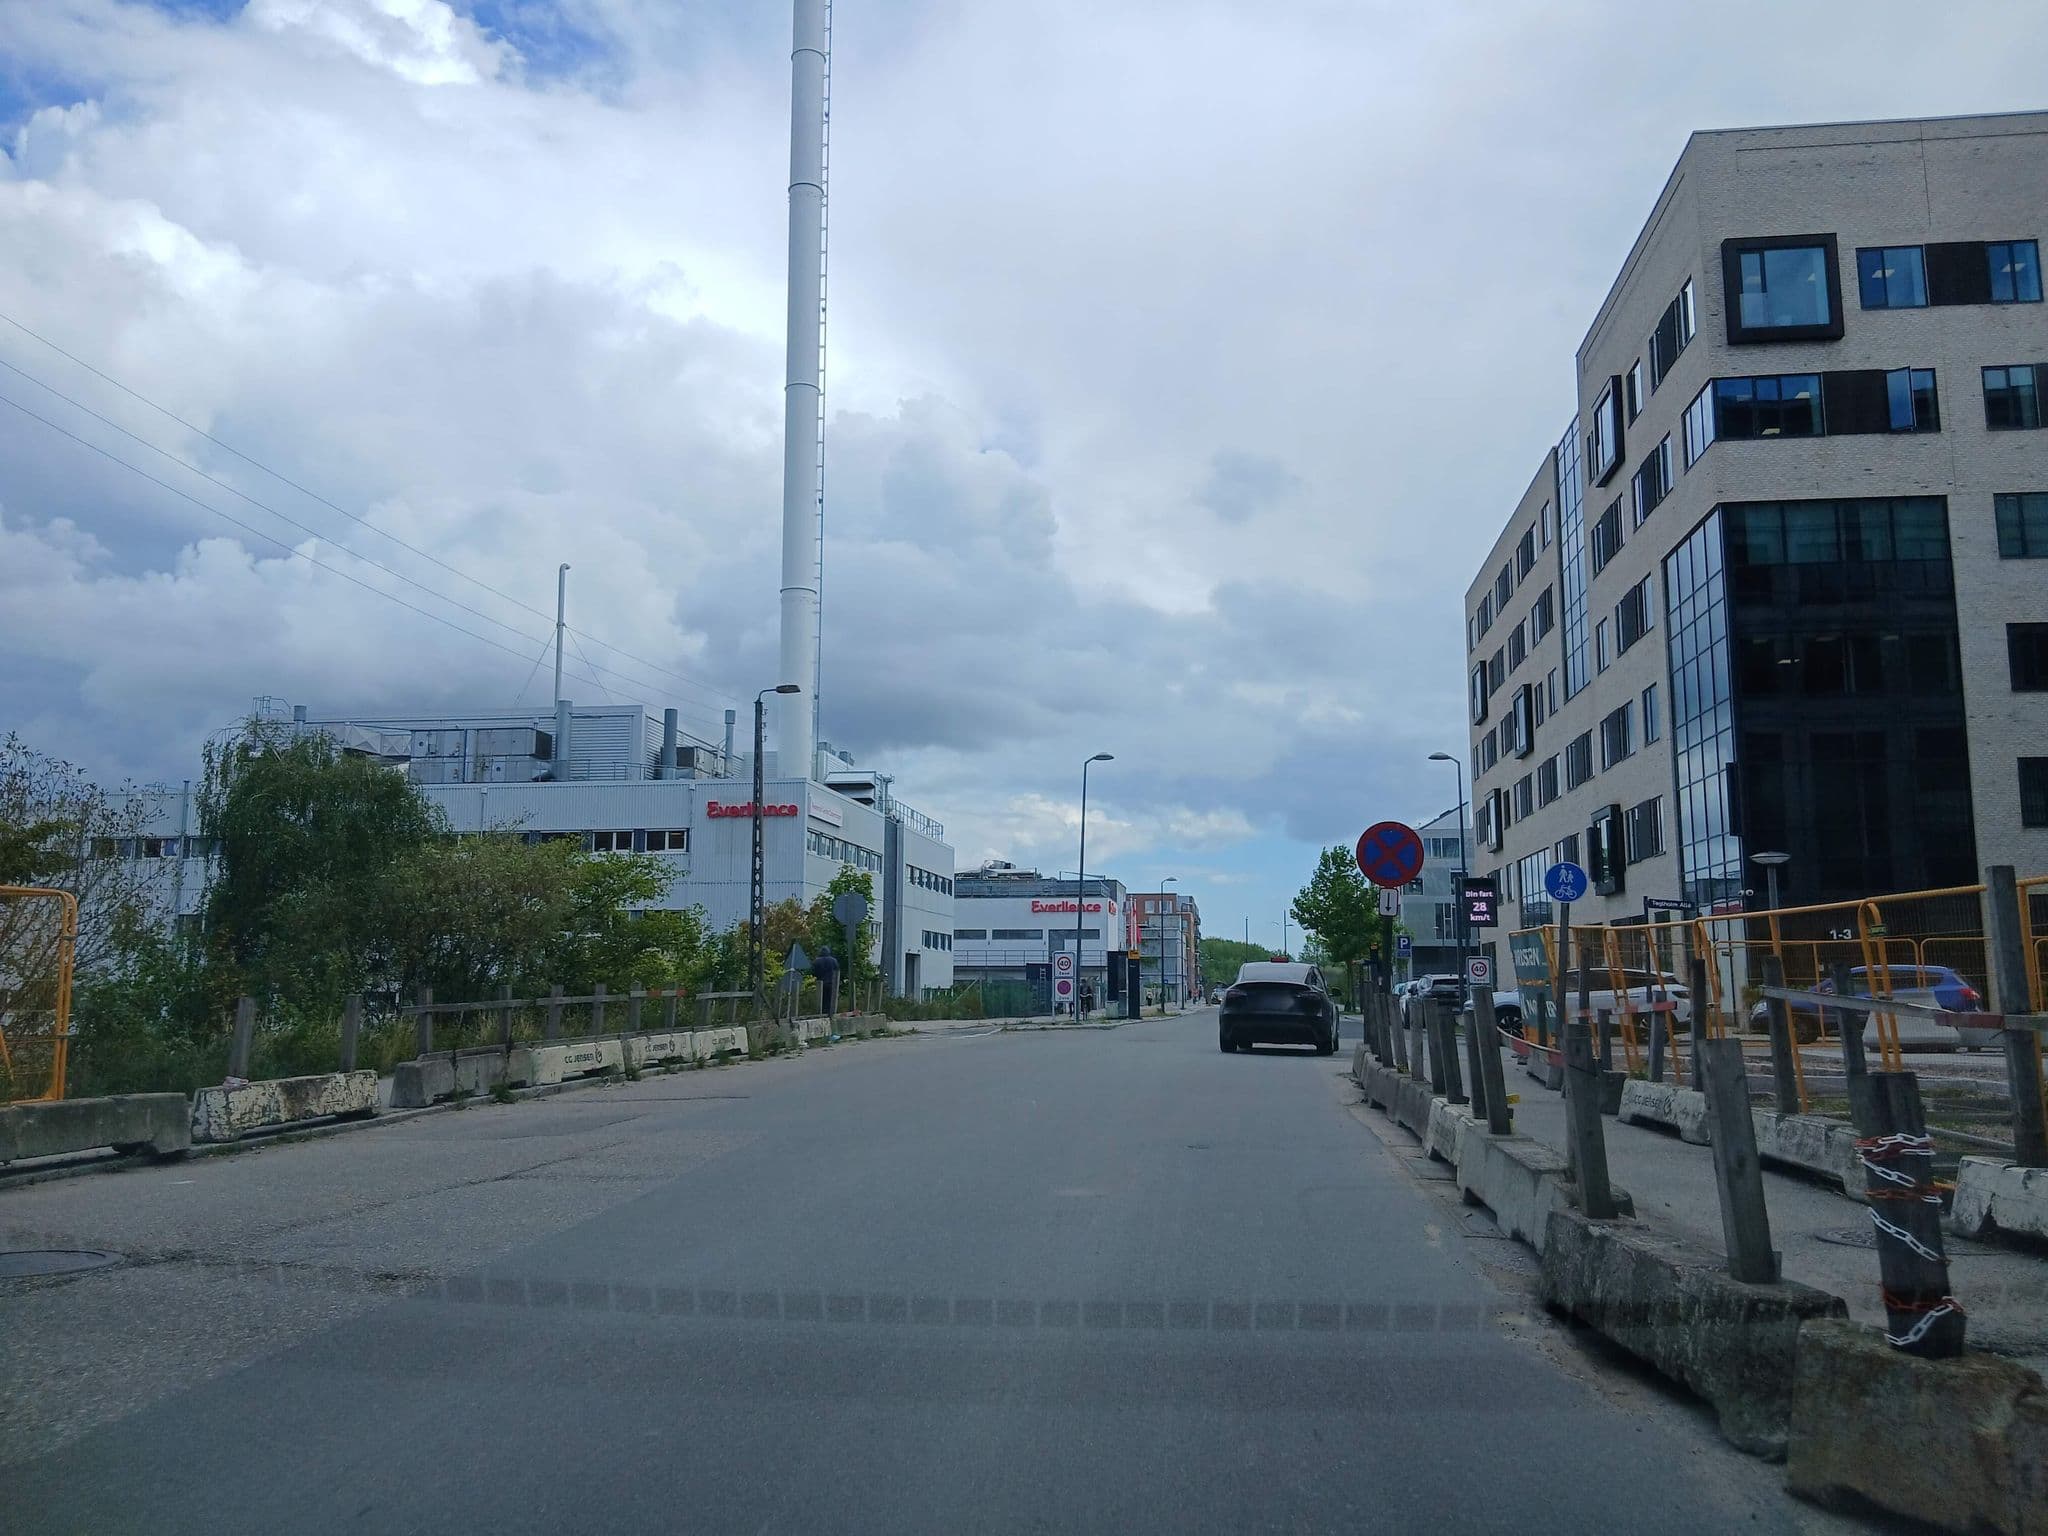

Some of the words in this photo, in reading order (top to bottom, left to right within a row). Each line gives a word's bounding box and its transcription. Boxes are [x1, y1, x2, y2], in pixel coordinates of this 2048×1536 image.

[1465, 890, 1478, 898] Din
[1479, 890, 1493, 898] fart
[1472, 902, 1487, 912] 28
[1830, 929, 1852, 940] 1-3
[1400, 938, 1408, 949] P
[1475, 965, 1485, 973] 40
